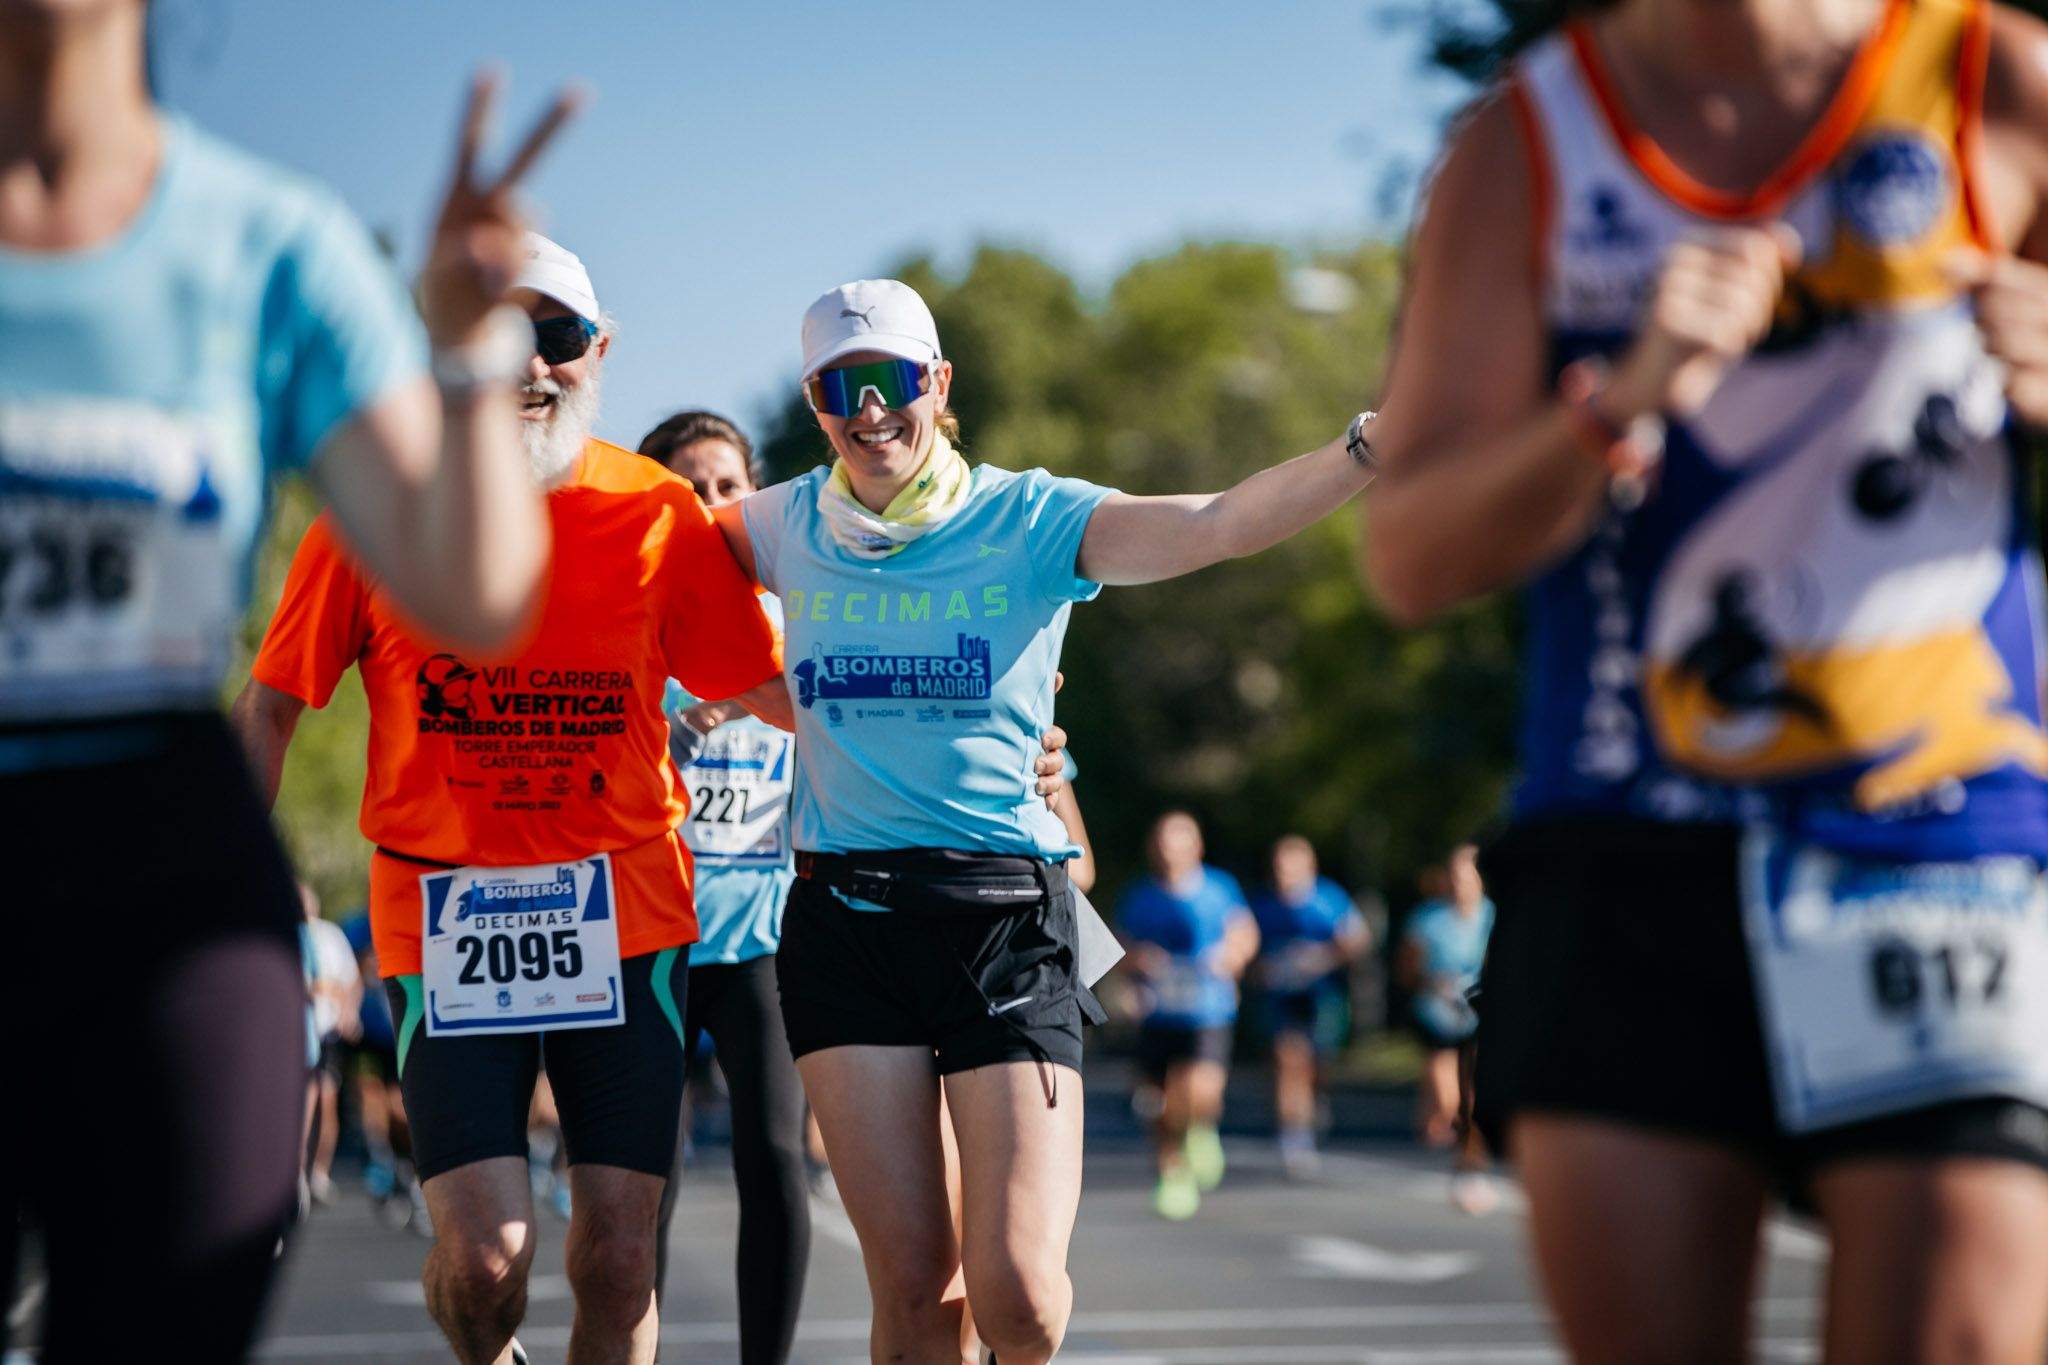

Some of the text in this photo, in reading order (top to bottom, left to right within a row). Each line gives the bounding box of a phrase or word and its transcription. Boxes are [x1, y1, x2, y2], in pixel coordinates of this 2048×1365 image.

[788, 584, 1008, 624] DECIMAS
[832, 644, 879, 654] CARRERA
[832, 657, 985, 677] BOMBEROS
[483, 666, 633, 690] VII CARRERA
[891, 677, 987, 697] de MADRID
[490, 693, 625, 716] VERTICAL
[419, 718, 626, 736] BOMBEROS DE MADRID
[455, 740, 596, 754] TORRE EMPERADOR
[479, 755, 573, 769] CASTELLANA
[484, 882, 572, 900] BOMBEROS
[475, 911, 573, 930] DECIMAS
[456, 930, 583, 985] 2095
